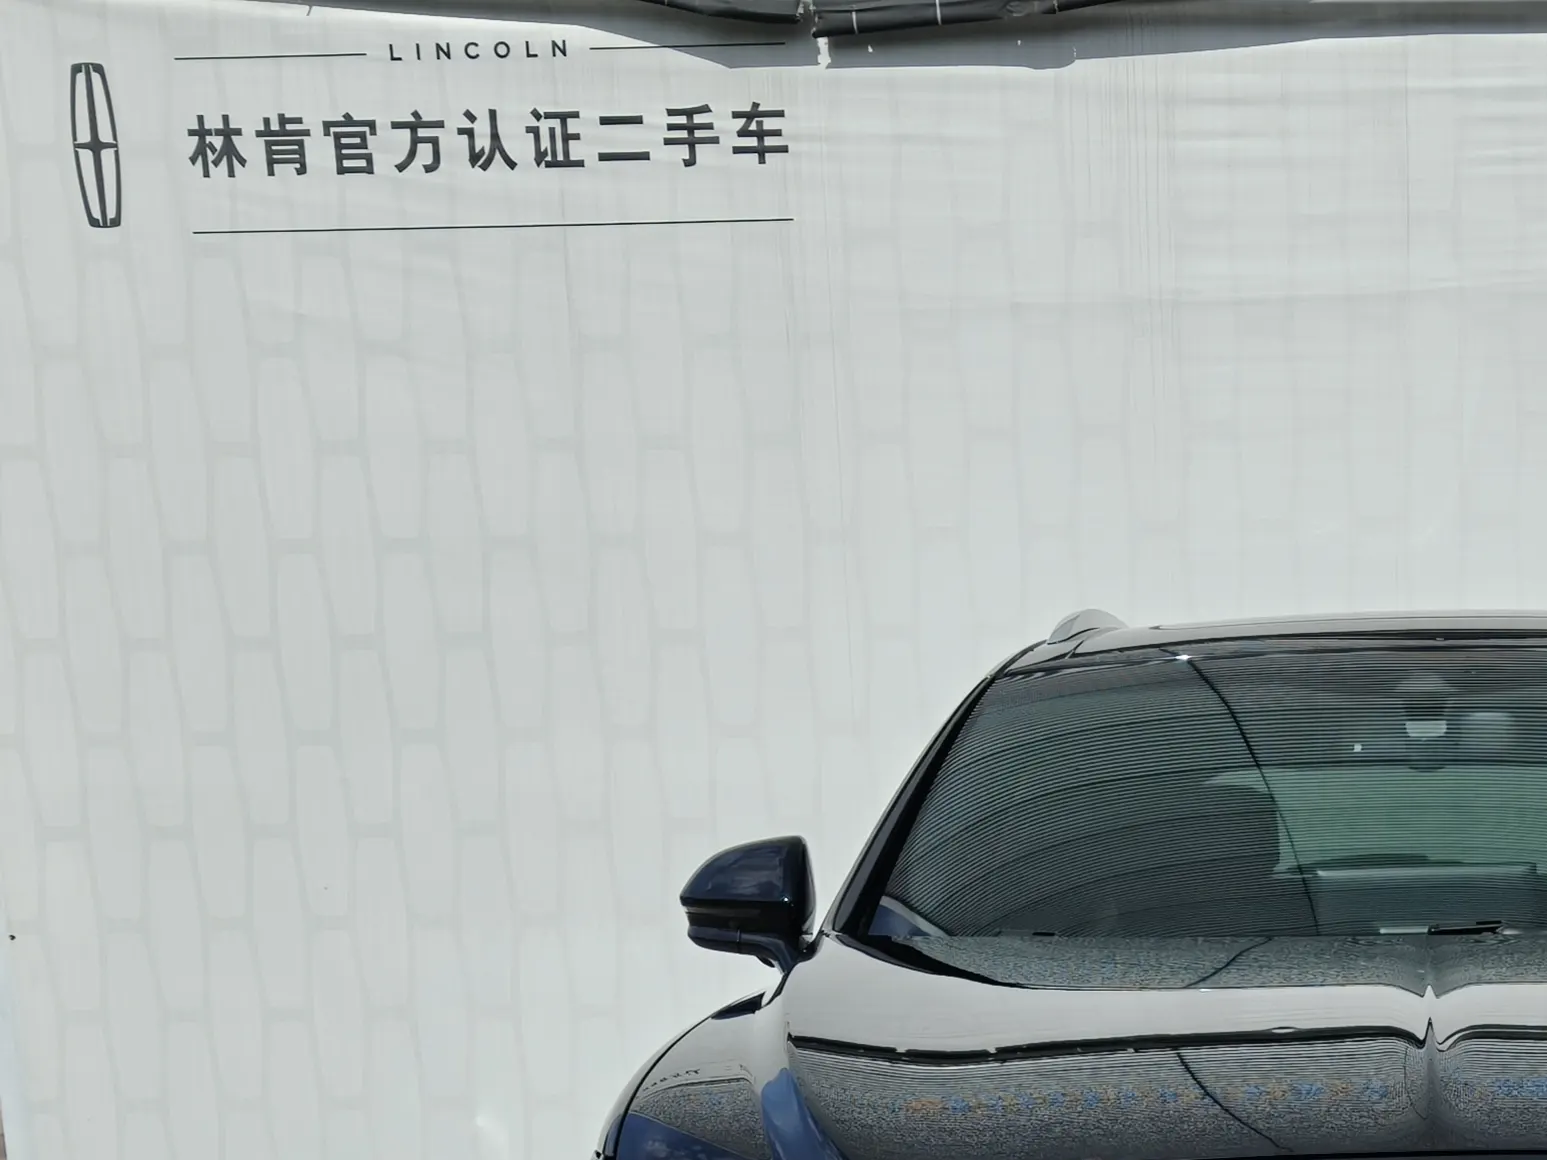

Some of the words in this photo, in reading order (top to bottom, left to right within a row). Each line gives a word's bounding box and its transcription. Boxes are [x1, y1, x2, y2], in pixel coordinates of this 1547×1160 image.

[388, 39, 570, 62] LINCOLN
[187, 101, 790, 179] 林肯官方认证二手车
